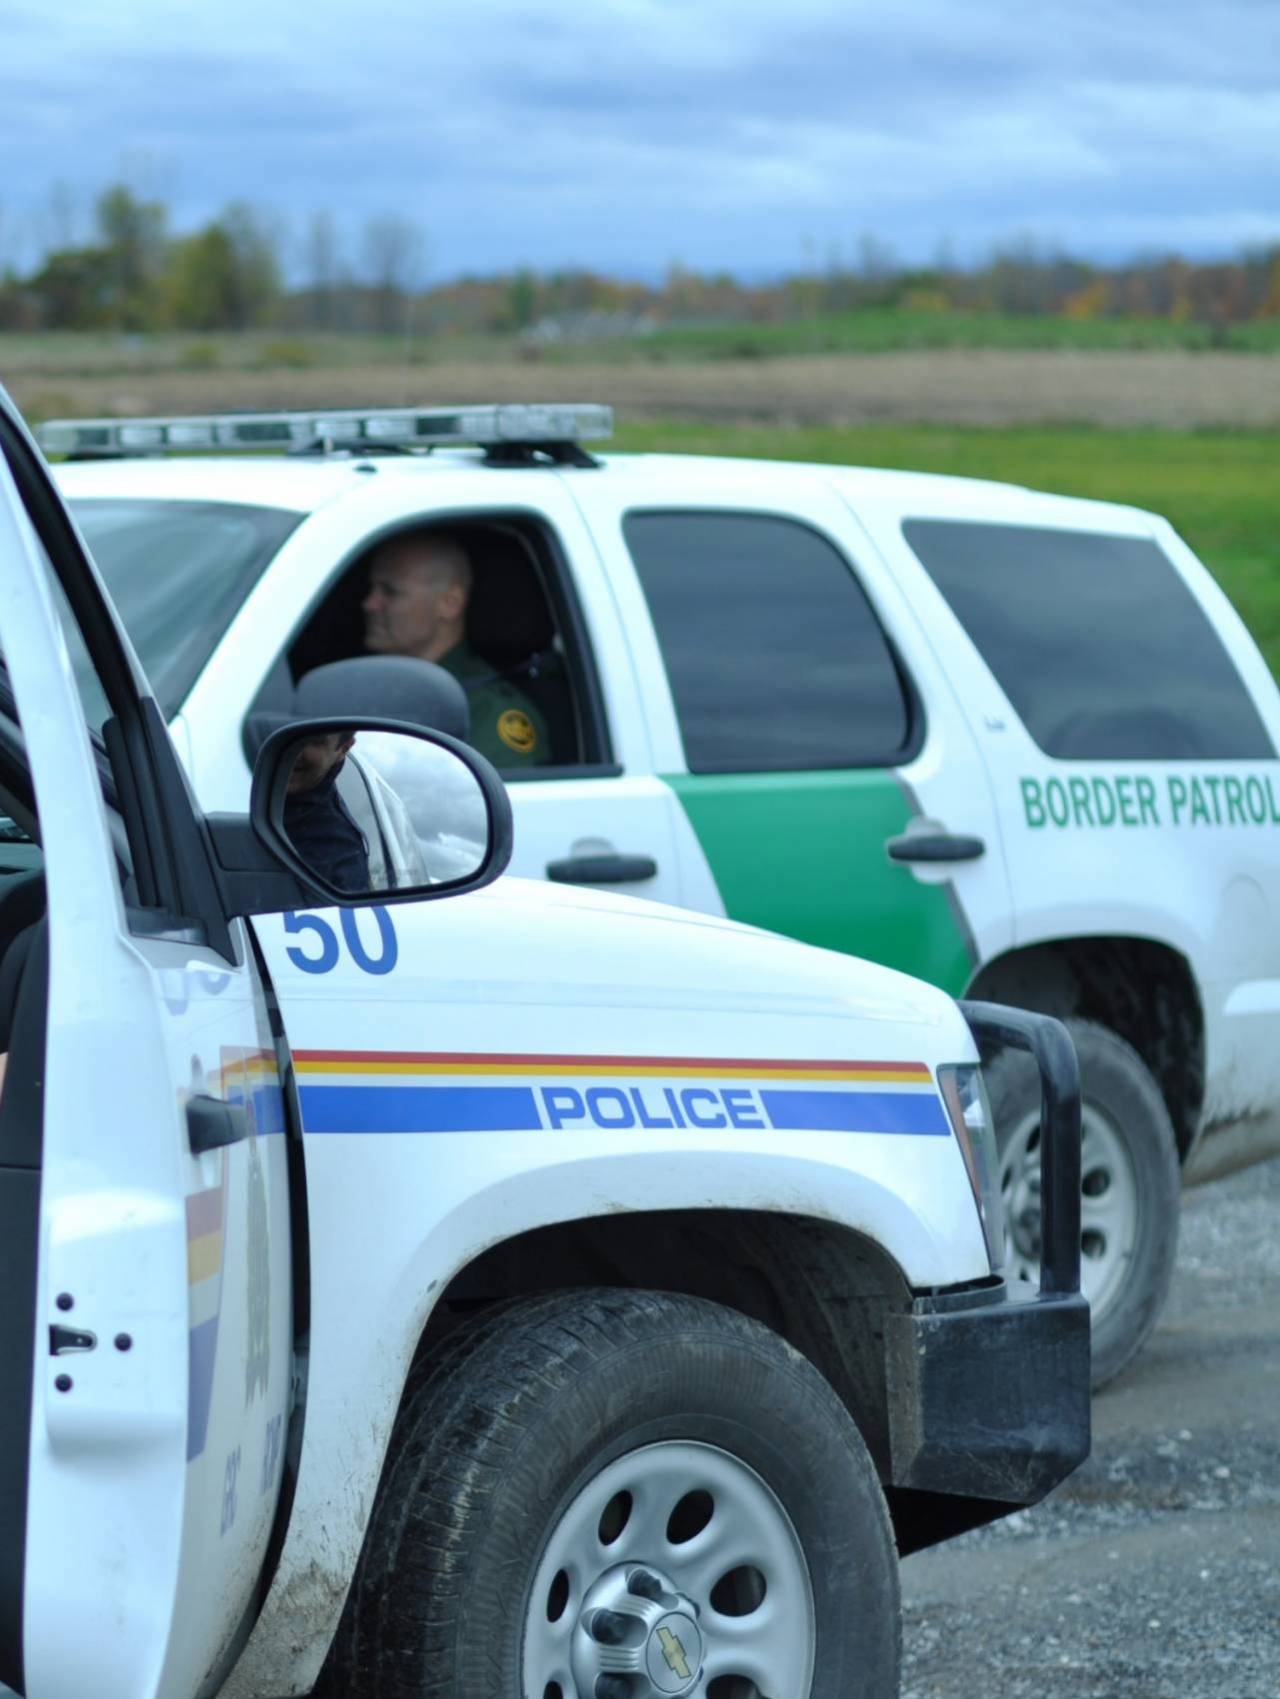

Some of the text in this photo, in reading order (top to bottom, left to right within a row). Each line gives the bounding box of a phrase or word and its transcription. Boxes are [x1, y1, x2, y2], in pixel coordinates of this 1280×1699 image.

[1020, 774, 1280, 828] BORDER PATROL
[283, 905, 398, 976] 50
[540, 1087, 766, 1129] POLICE
